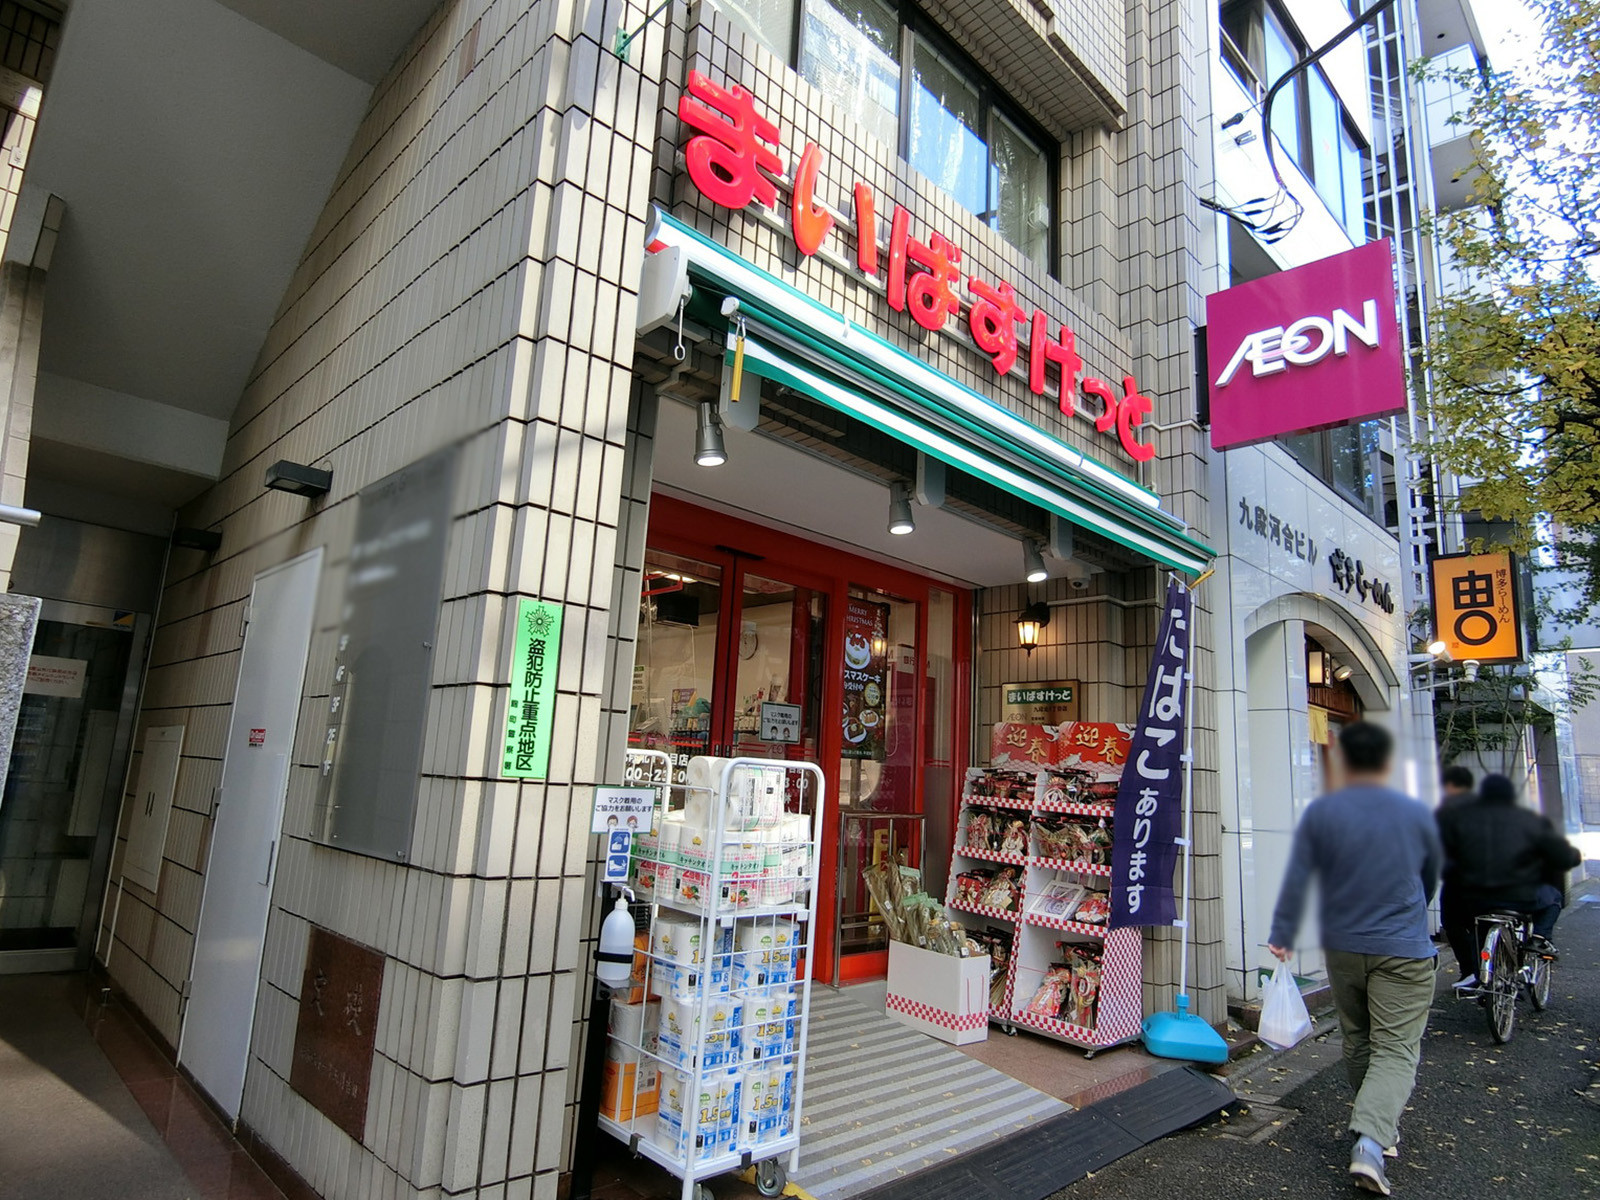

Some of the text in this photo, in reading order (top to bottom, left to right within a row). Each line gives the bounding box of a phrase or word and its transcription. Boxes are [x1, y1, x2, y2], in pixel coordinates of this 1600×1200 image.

[678, 69, 1155, 461] まいばすけっと
[1239, 497, 1318, 566] 九段河合ビル
[1496, 569, 1510, 623] 博多らーめん
[515, 637, 546, 771] 盗犯防止重点地区
[1008, 690, 1071, 702] まいばすけっと
[1007, 726, 1047, 766] 迎春
[1075, 725, 1123, 766] 迎春
